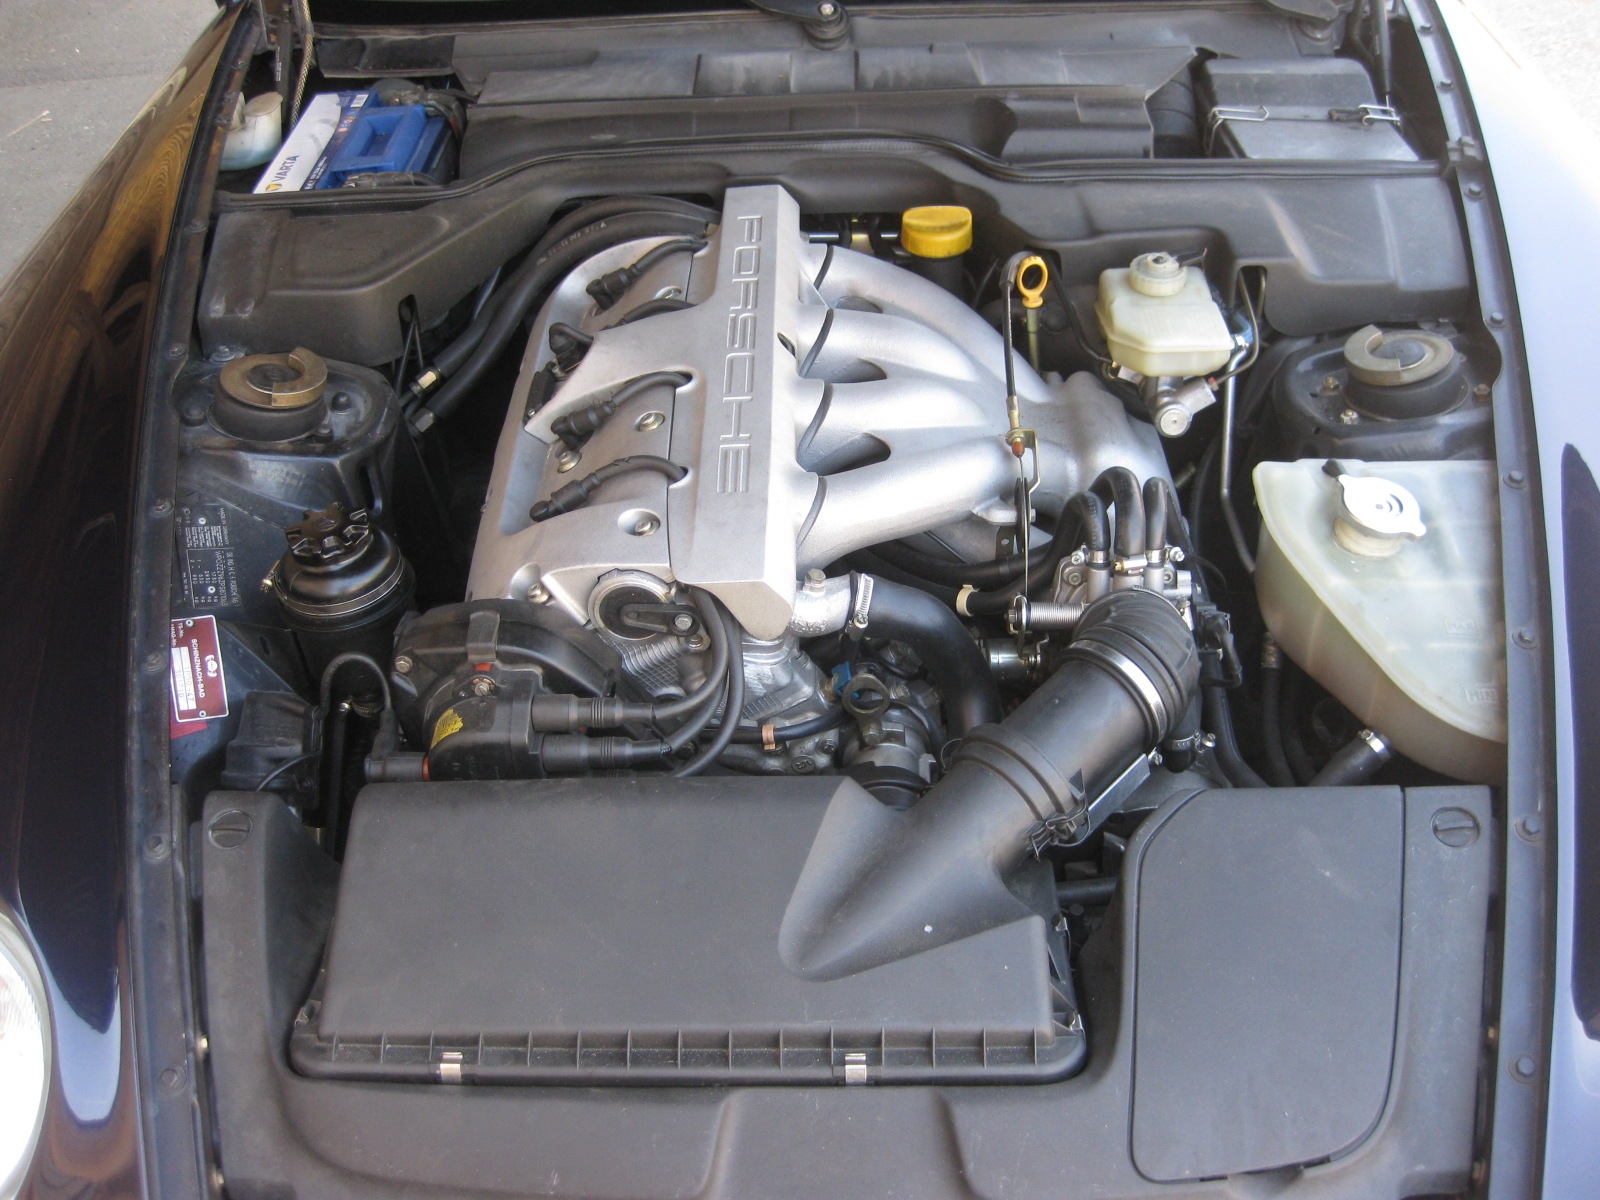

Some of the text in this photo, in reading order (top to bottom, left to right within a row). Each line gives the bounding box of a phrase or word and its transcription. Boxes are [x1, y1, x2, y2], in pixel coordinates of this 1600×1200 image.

[271, 154, 300, 182] VARTA
[716, 214, 763, 494] PORSCHE
[191, 638, 206, 698] SCHINZNACH-BAD
